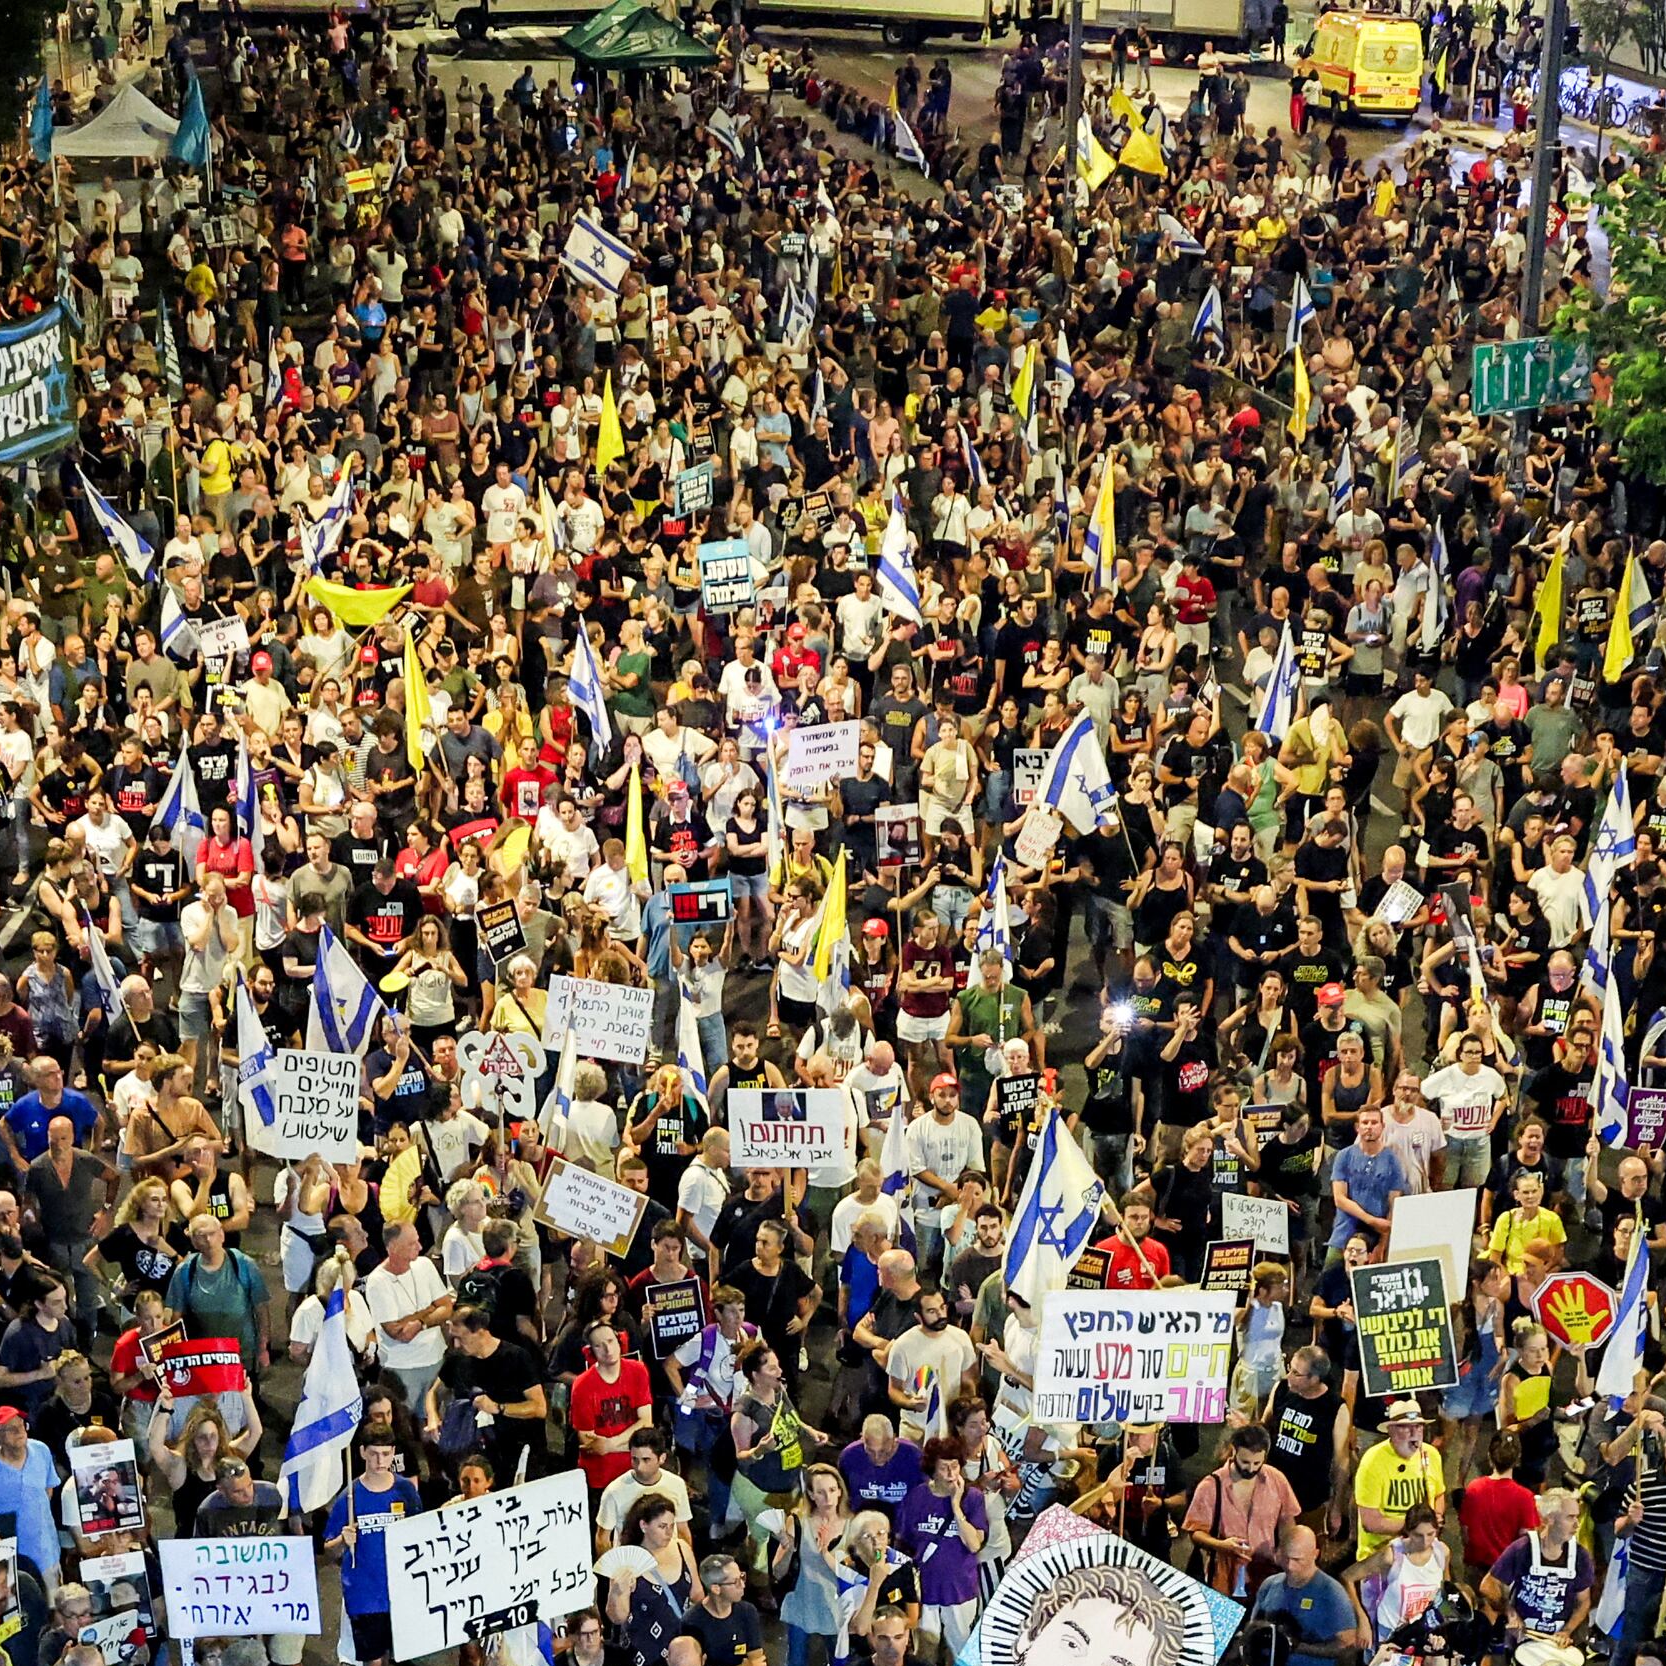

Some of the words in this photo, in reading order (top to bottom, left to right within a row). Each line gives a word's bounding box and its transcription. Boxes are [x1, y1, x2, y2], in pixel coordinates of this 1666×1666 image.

[285, 1054, 357, 1078] חטופים
[297, 1076, 355, 1099] וחיילים
[279, 1094, 331, 1116] מזבח
[335, 1102, 354, 1118] על
[657, 1311, 698, 1327] מסרבים
[1063, 1309, 1134, 1336] החפץ
[1137, 1310, 1200, 1335] האיש
[1202, 1311, 1231, 1330] מי
[1427, 1306, 1445, 1326] די
[165, 1355, 201, 1370] הרקין
[202, 1351, 241, 1366] מקסים
[1053, 1348, 1091, 1378] ועשה
[1093, 1342, 1133, 1380] מרע
[1134, 1346, 1164, 1376] סור
[1165, 1344, 1230, 1380] חיים
[1077, 1384, 1131, 1422] שלום
[1132, 1393, 1164, 1422] בקש
[1165, 1382, 1227, 1424] טוב
[1295, 1412, 1313, 1429] למה
[1282, 1421, 1318, 1445] עדיין
[195, 1543, 289, 1566] התשובה
[404, 1532, 472, 1562] צרוב
[193, 1570, 289, 1596] לבגידה
[181, 1604, 251, 1626] אזרחי
[273, 1602, 311, 1622] מרי
[429, 1596, 483, 1646] חייך
